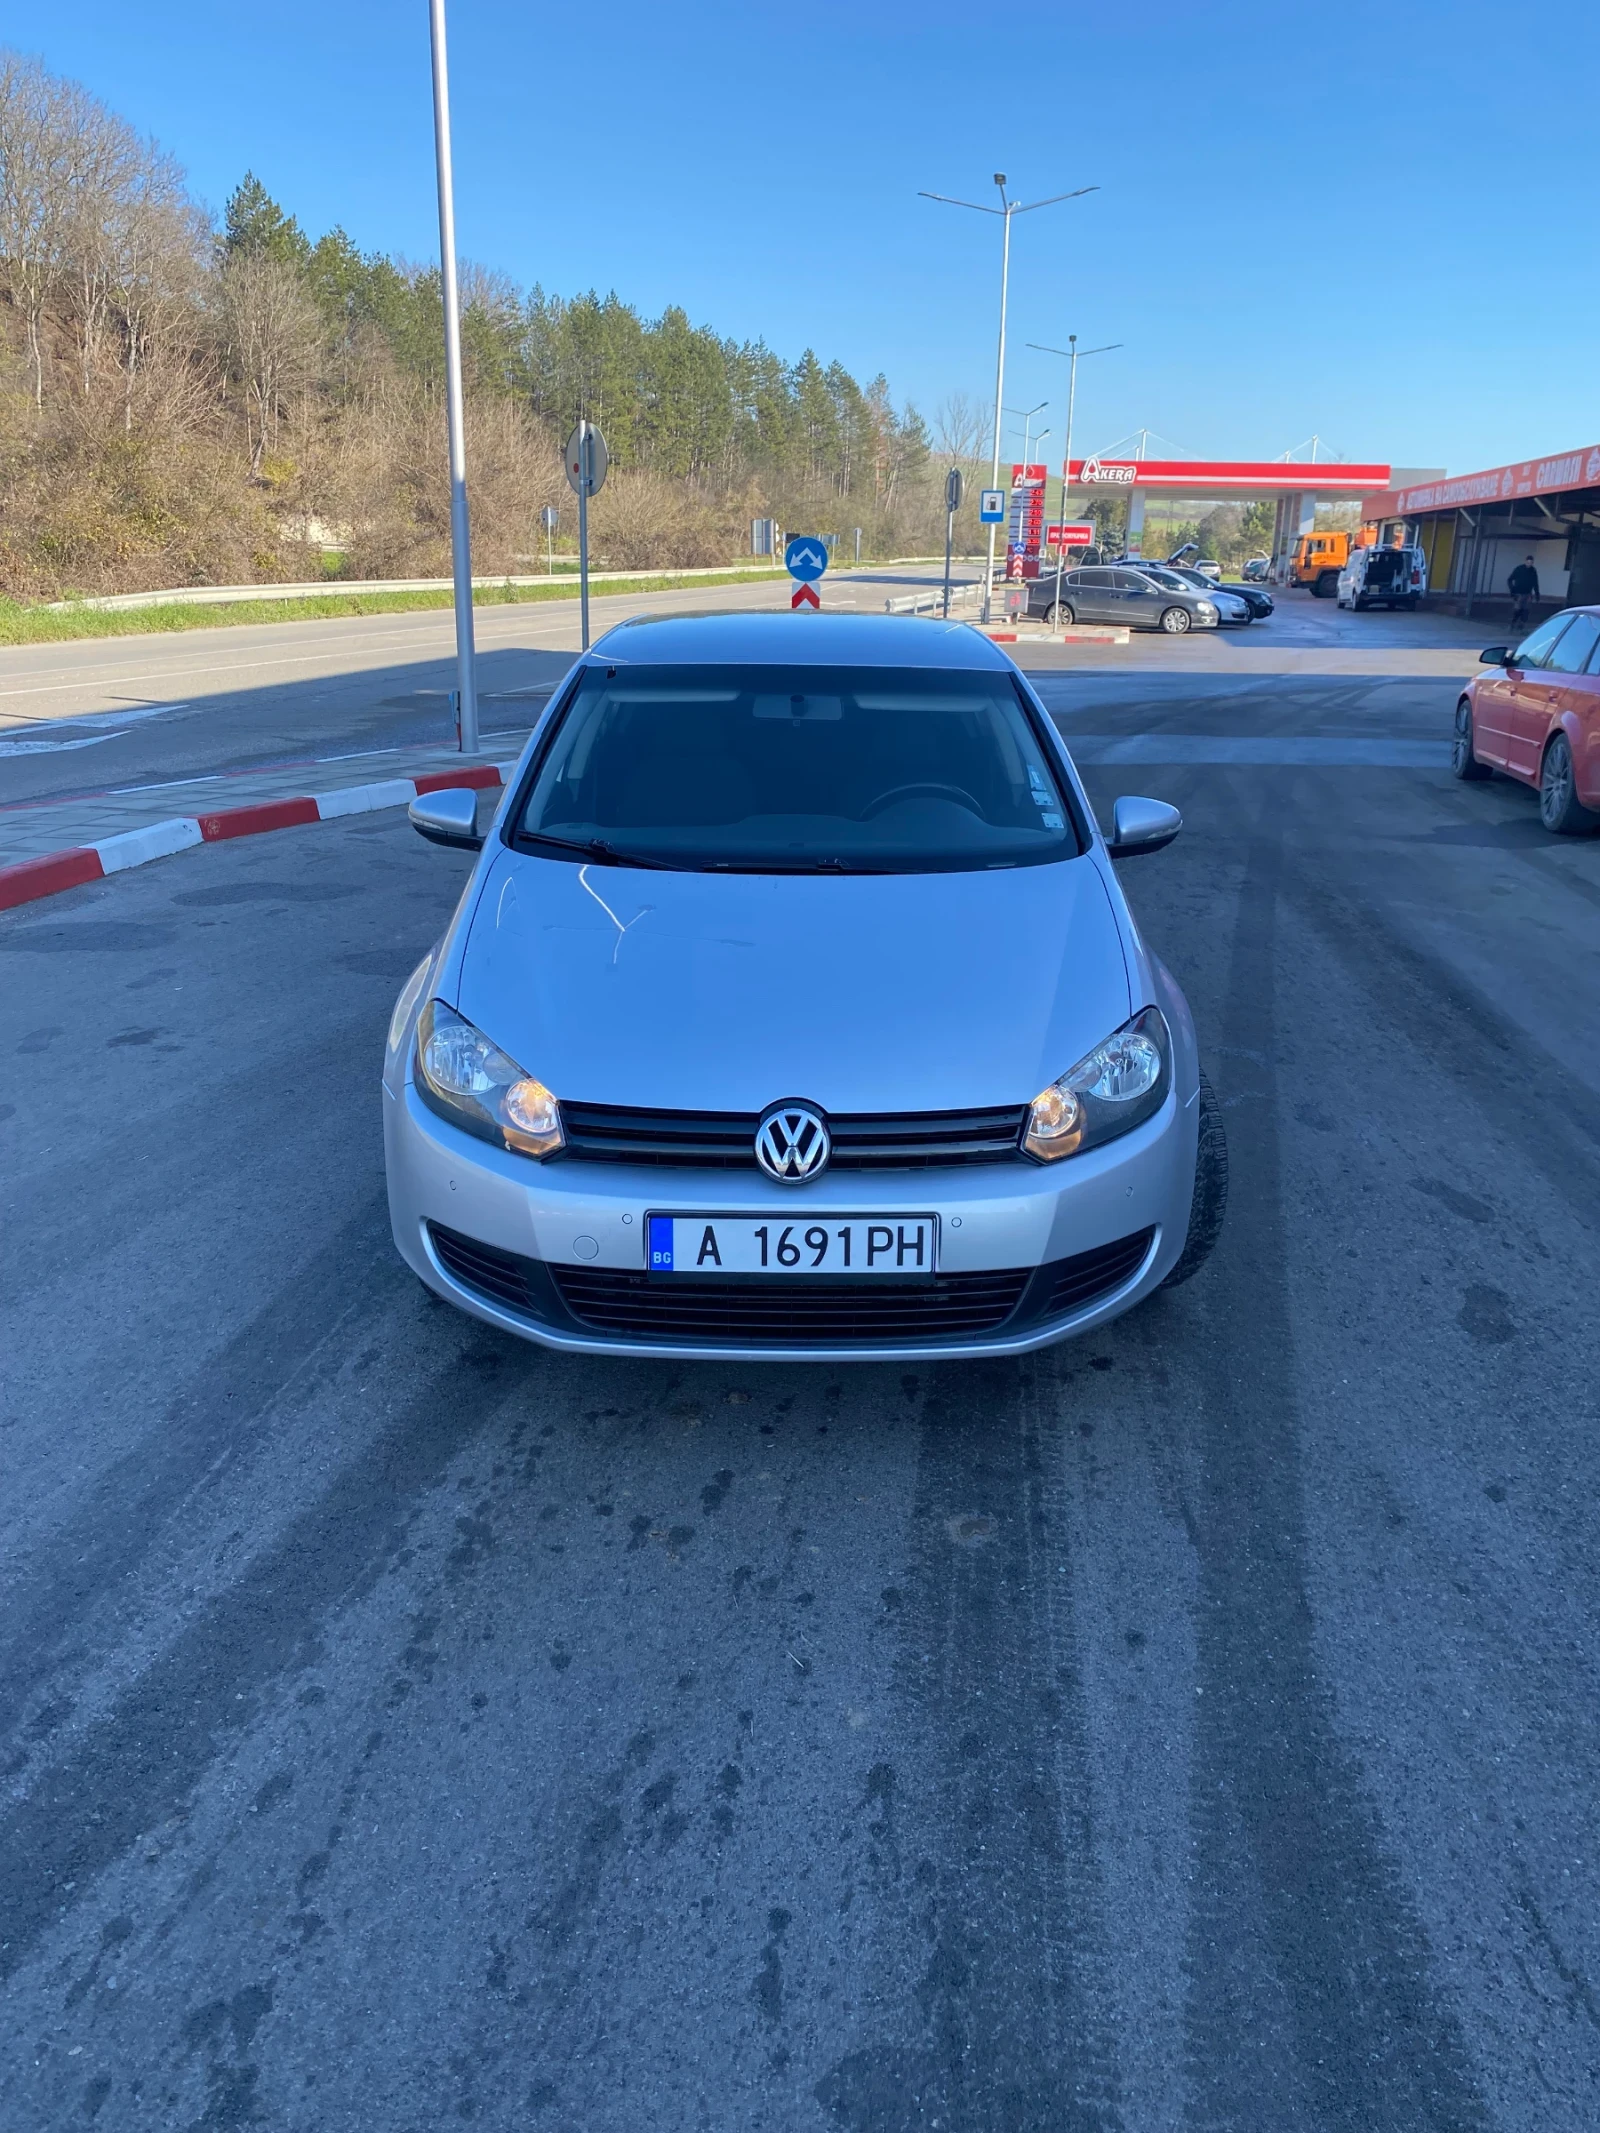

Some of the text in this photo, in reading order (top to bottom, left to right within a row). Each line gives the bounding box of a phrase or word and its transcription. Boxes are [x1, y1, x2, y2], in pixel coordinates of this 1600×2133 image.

[1081, 456, 1136, 483] AKERA
[1536, 455, 1582, 488] CARWASH
[758, 1111, 826, 1180] VW
[653, 1252, 672, 1264] BG
[696, 1225, 722, 1266] A
